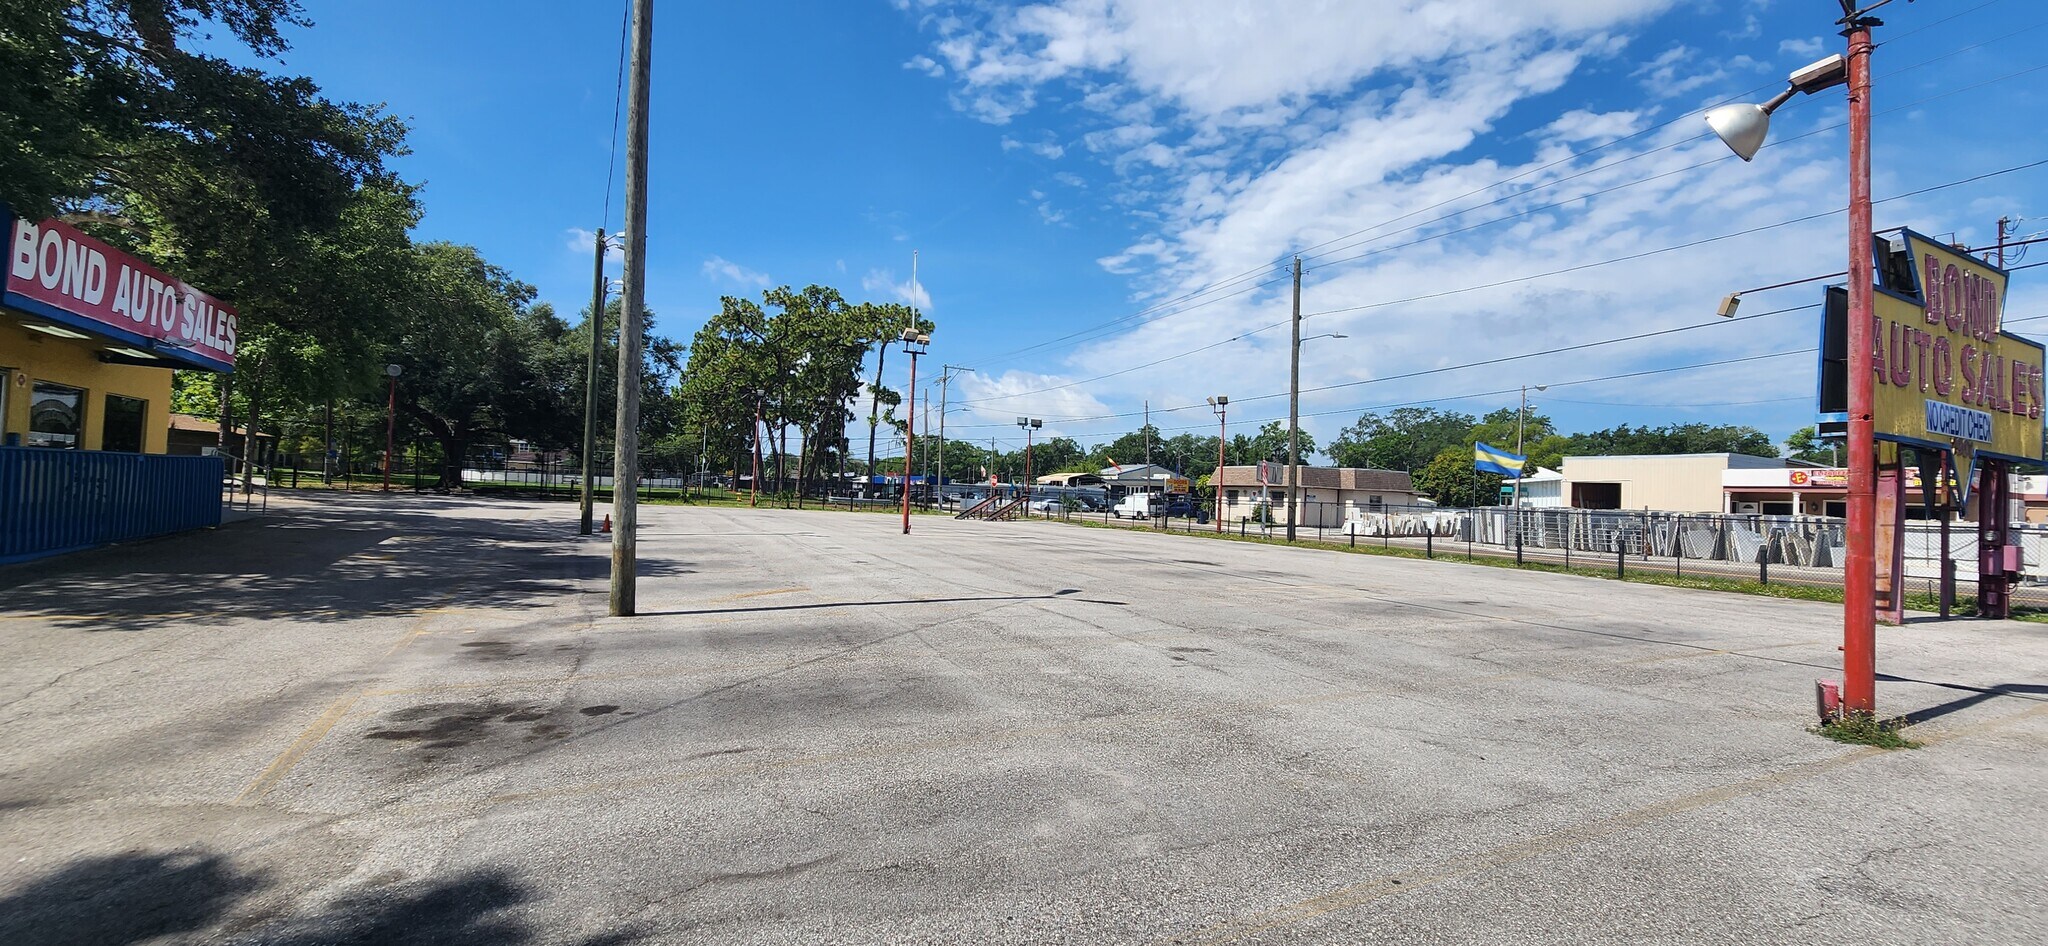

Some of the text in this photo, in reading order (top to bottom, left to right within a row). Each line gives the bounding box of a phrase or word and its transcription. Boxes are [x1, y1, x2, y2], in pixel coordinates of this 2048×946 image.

[12, 217, 237, 356] BOND AUTO SALES
[1925, 253, 1999, 343] BOND
[1872, 315, 2043, 419] AUTO SALES
[1926, 401, 1993, 441] NO CREDIT CHECK
